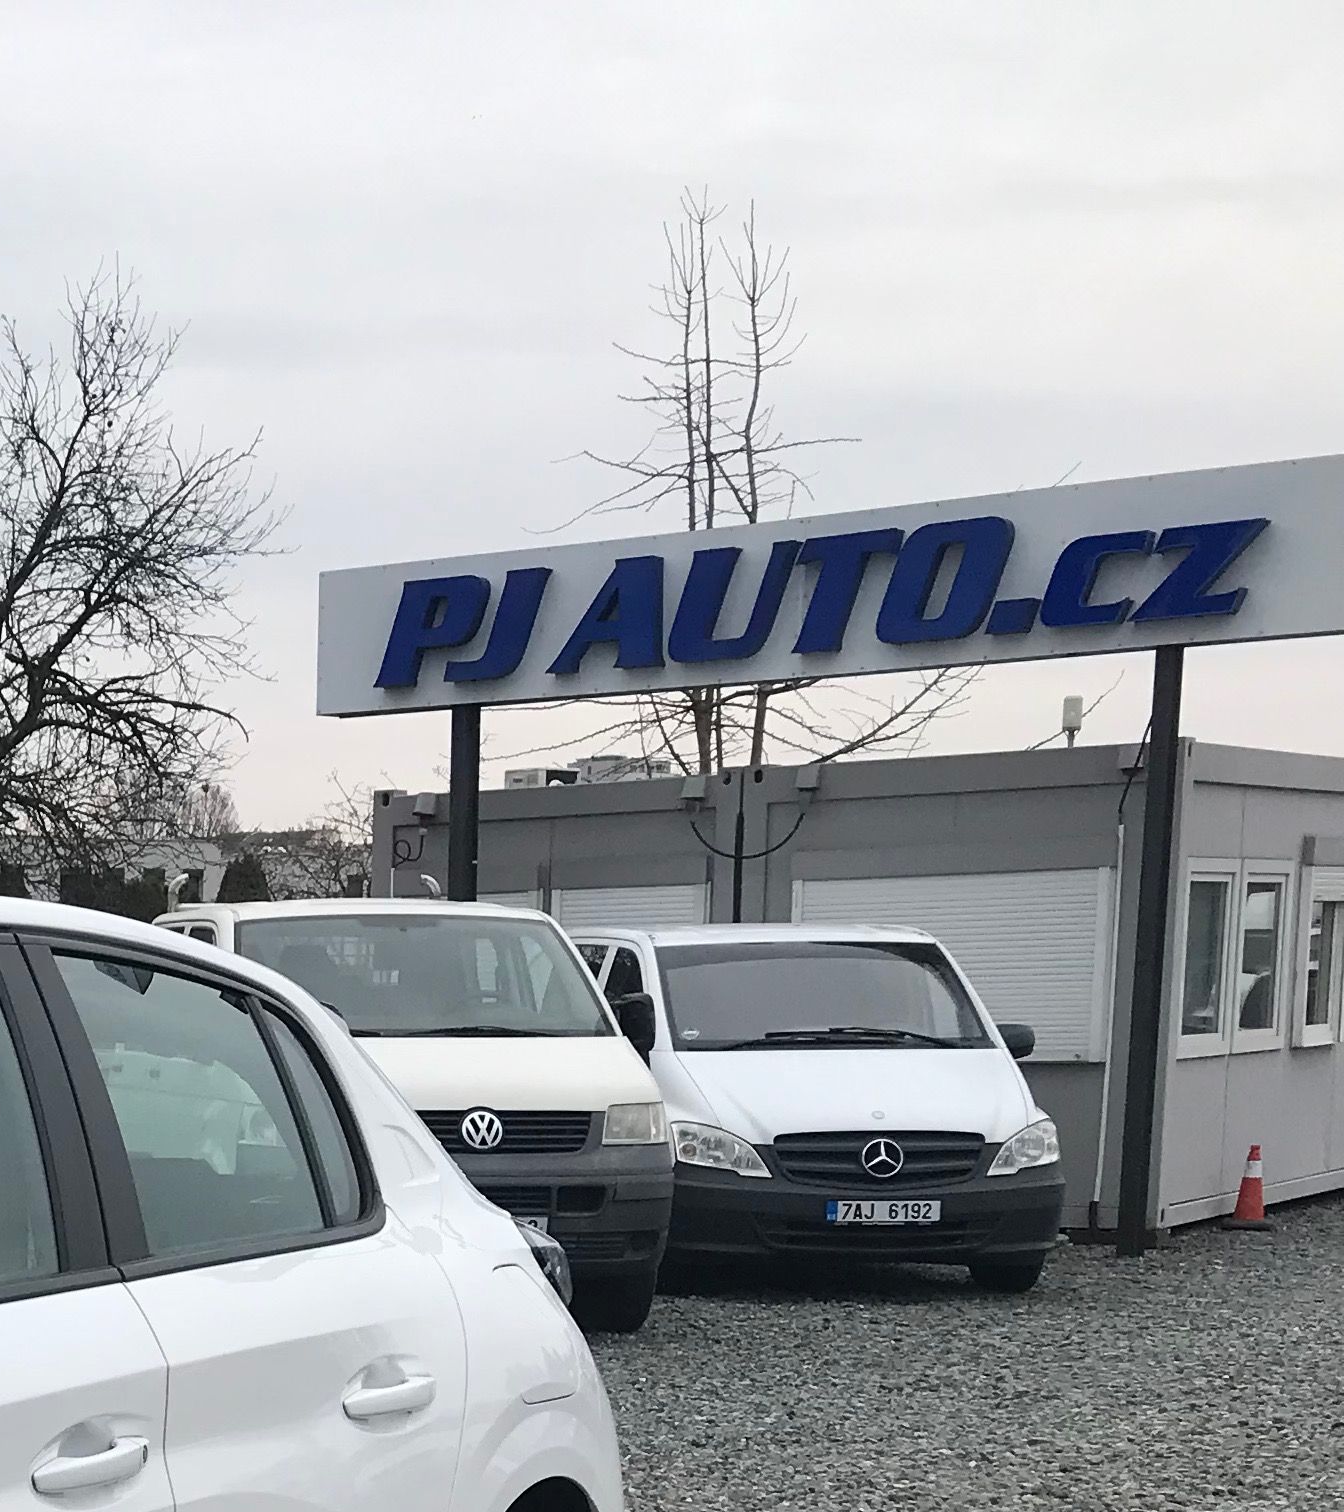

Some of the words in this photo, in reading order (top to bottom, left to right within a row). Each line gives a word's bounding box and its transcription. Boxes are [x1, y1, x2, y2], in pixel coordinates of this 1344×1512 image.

[374, 566, 553, 689] PJ
[462, 1111, 503, 1149] VW
[842, 1203, 875, 1220] 7AJ
[888, 1203, 932, 1220] 6192
